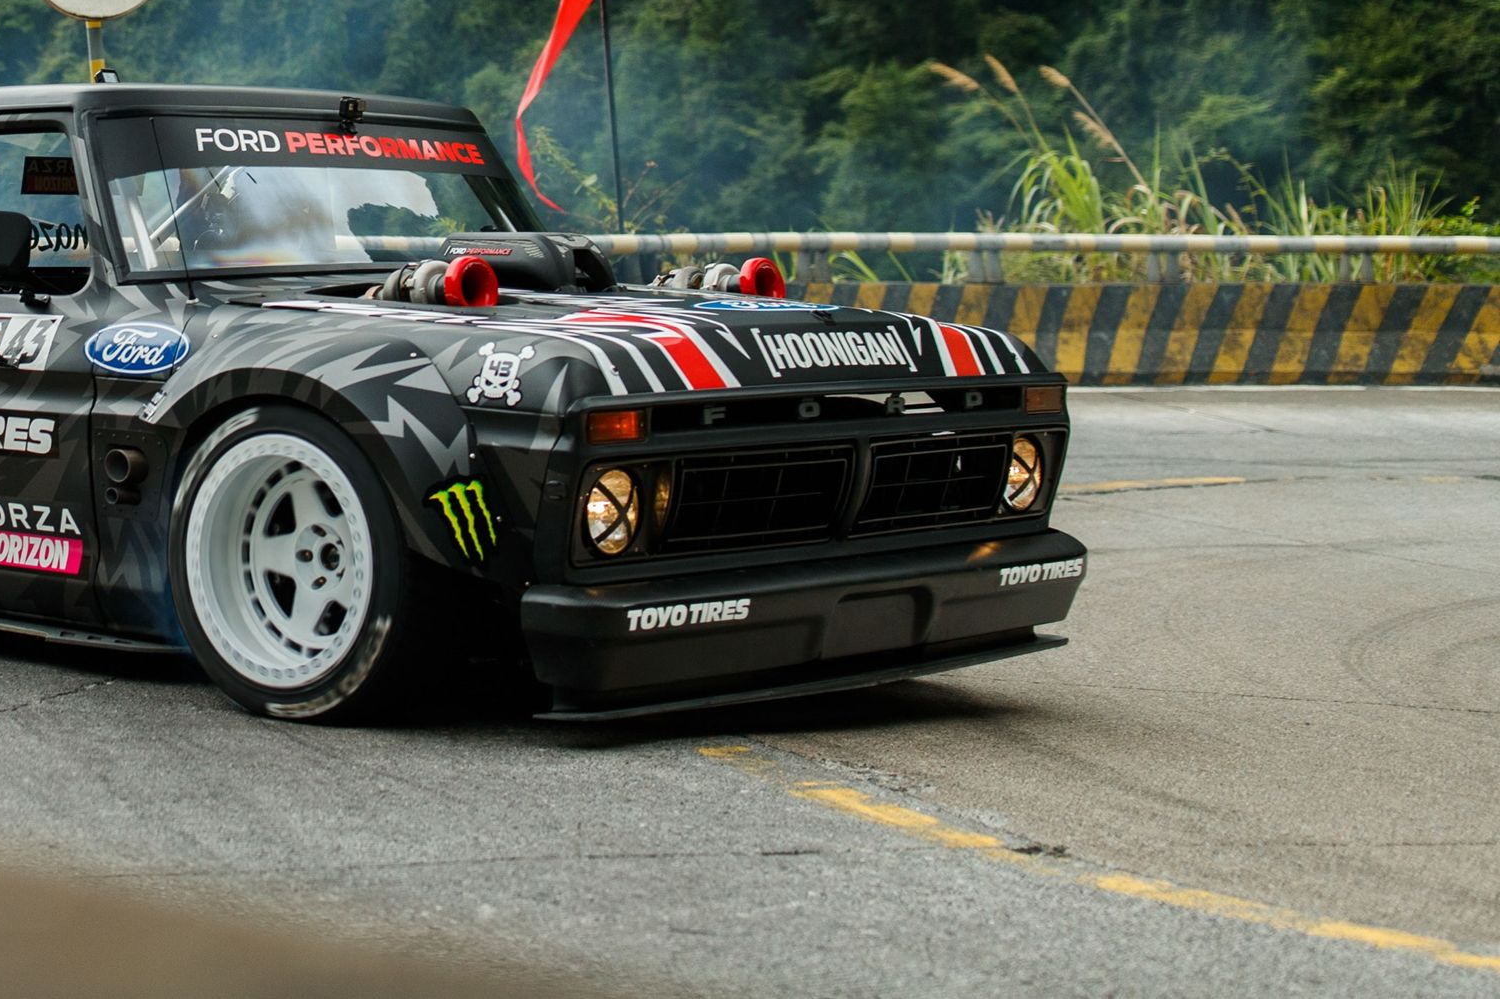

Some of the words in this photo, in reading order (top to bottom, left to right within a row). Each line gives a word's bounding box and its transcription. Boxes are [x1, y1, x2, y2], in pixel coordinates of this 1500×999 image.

[195, 128, 281, 153] FORD
[284, 131, 485, 165] PERFORMANCE
[449, 247, 466, 255] FORD
[101, 327, 172, 367] Ford
[488, 359, 514, 378] 43
[1000, 563, 1042, 587] TOYO
[1041, 558, 1084, 581] TIRES
[627, 604, 688, 632] TOYO
[689, 598, 751, 625] TIRES
